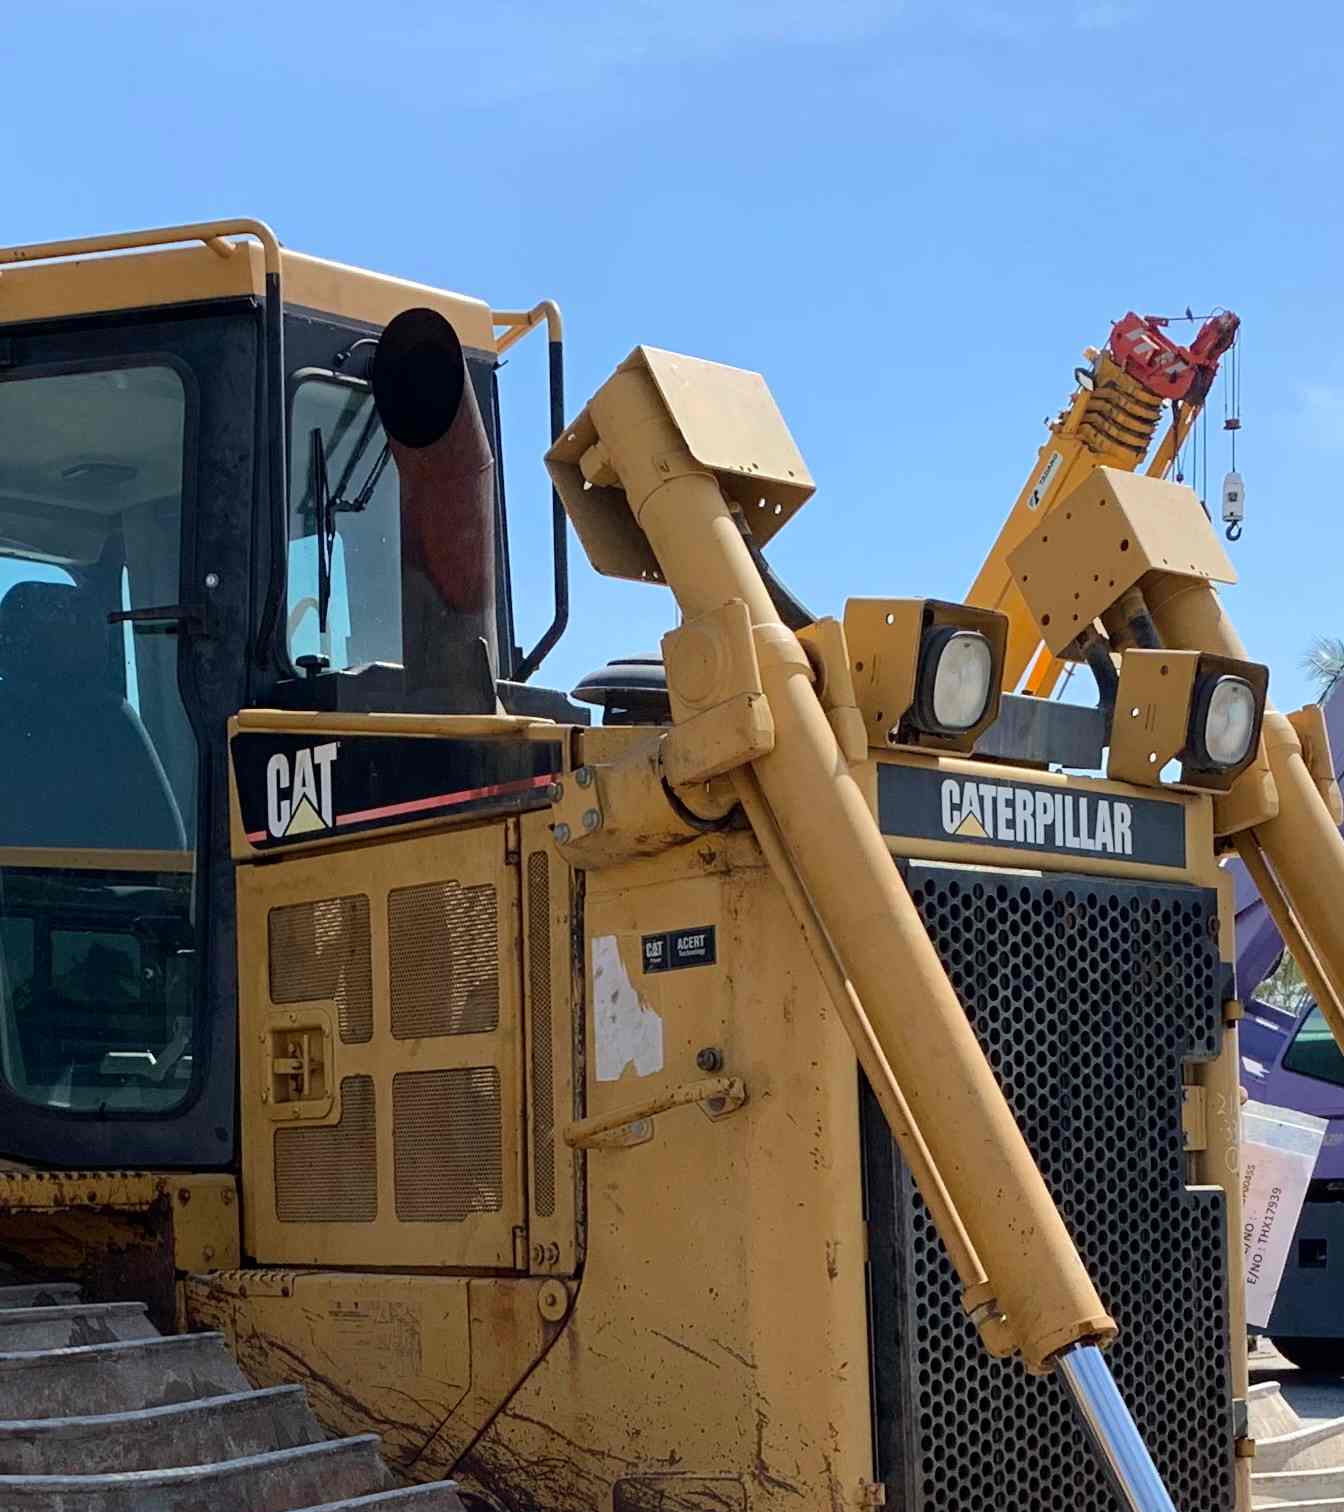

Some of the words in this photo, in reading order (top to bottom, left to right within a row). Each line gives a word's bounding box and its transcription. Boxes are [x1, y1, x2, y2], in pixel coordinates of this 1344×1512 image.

[267, 742, 338, 838] CAT
[941, 778, 1133, 855] CATERPILLAR
[646, 940, 664, 958] CAT
[677, 934, 705, 950] ACERT
[1247, 1253, 1263, 1285] E/NO
[1258, 1187, 1282, 1245] THX17939
